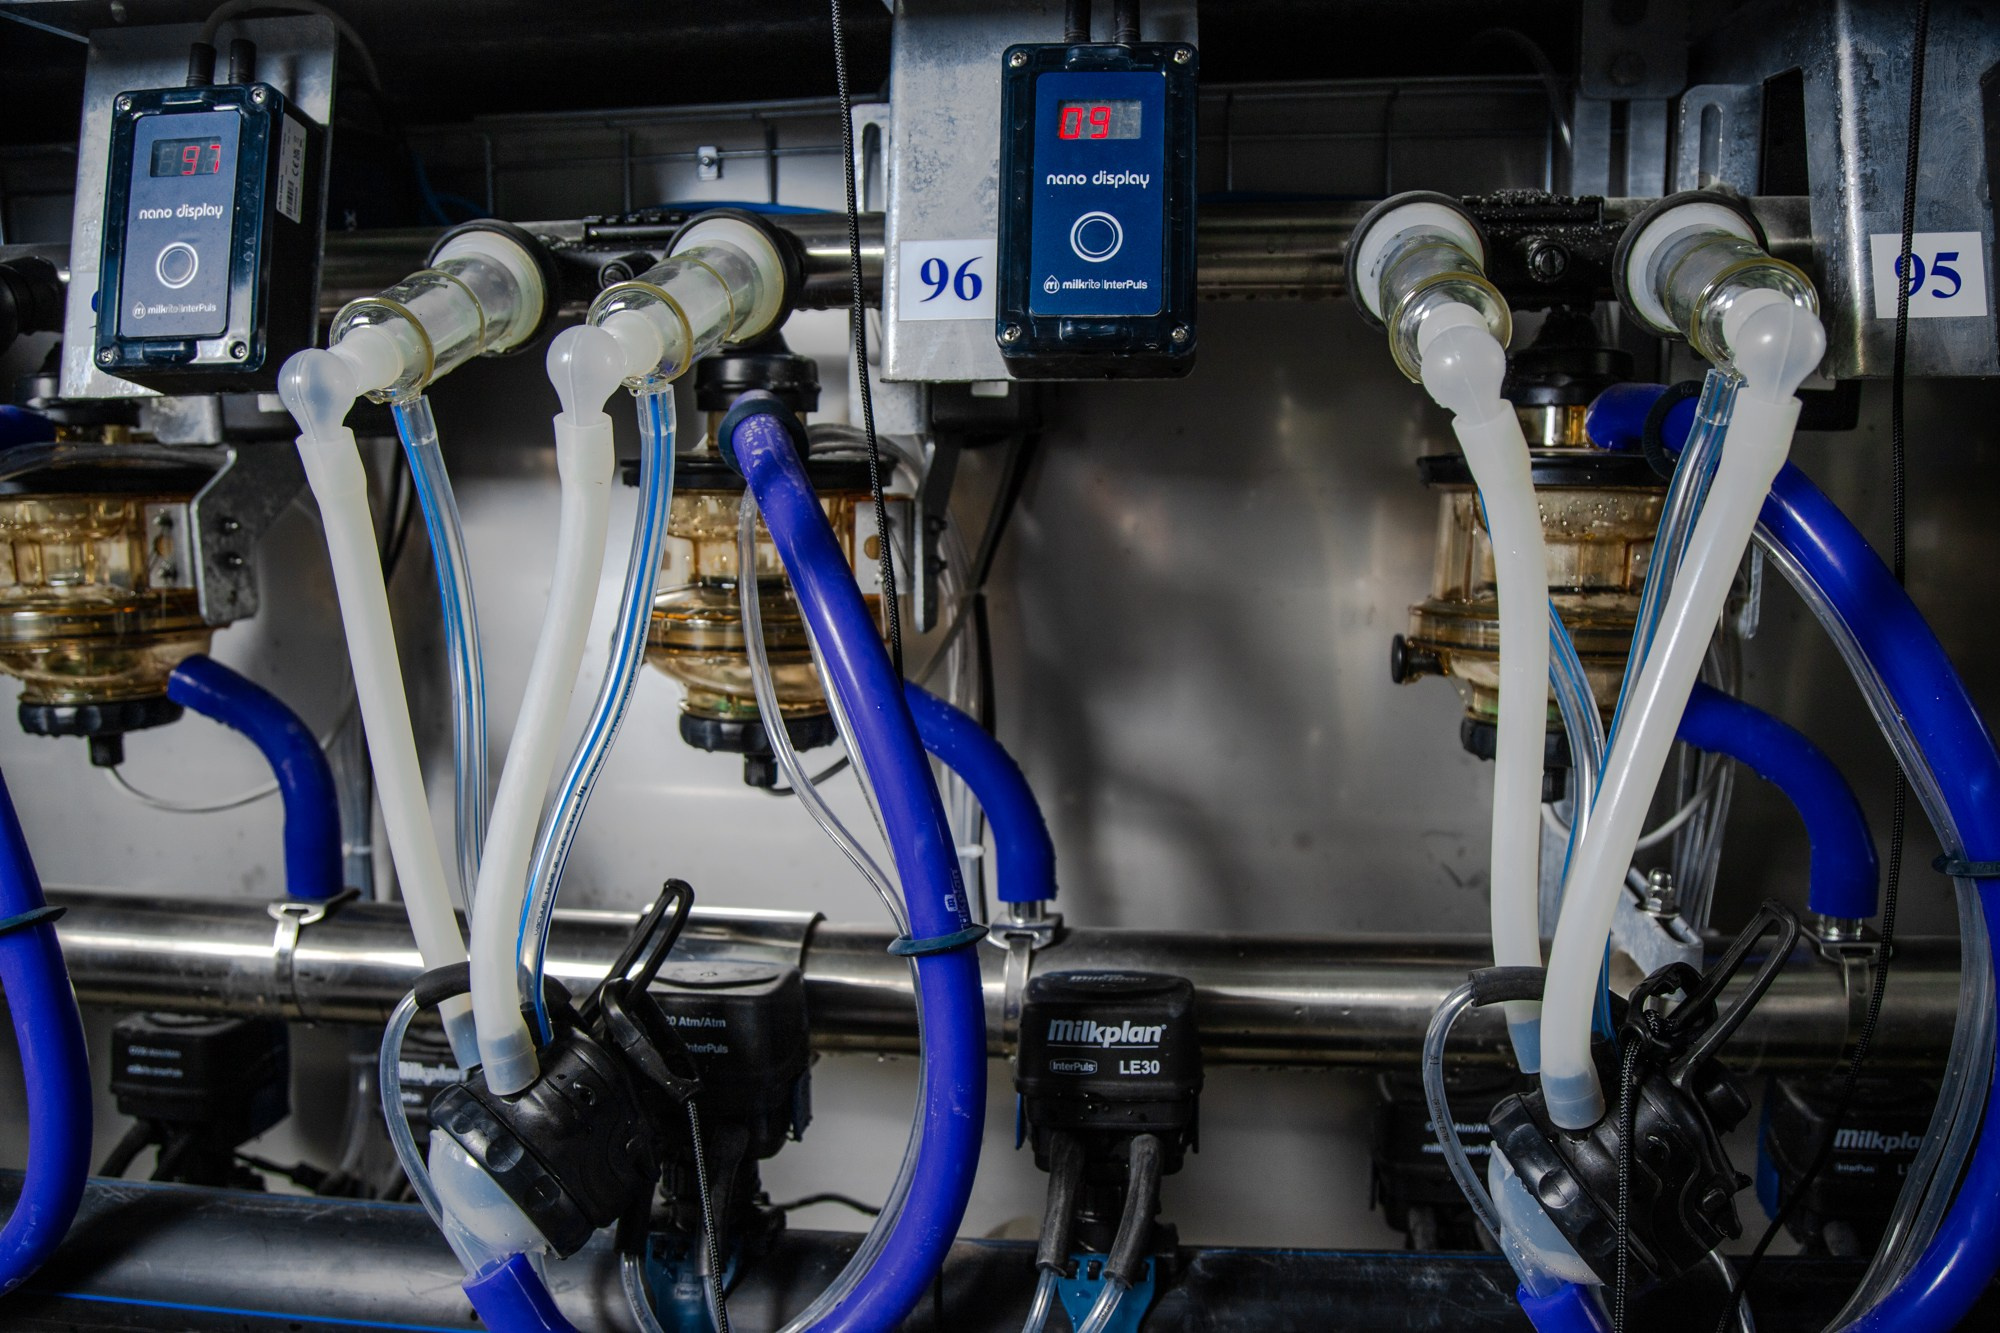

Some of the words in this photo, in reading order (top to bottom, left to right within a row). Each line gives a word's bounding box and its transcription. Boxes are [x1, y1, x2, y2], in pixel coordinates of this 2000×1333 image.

[1058, 106, 1111, 140] 09
[181, 144, 221, 175] 97
[1046, 173, 1087, 185] nano
[1092, 170, 1150, 189] display
[138, 207, 173, 220] nano
[176, 203, 224, 220] display
[919, 255, 984, 303] 96
[1894, 251, 1962, 299] 95
[678, 1016, 726, 1028] Atm/Atm
[1052, 1060, 1096, 1072] InterPuls
[1119, 1060, 1161, 1075] LE30
[1833, 1128, 1925, 1154] Milkpla
